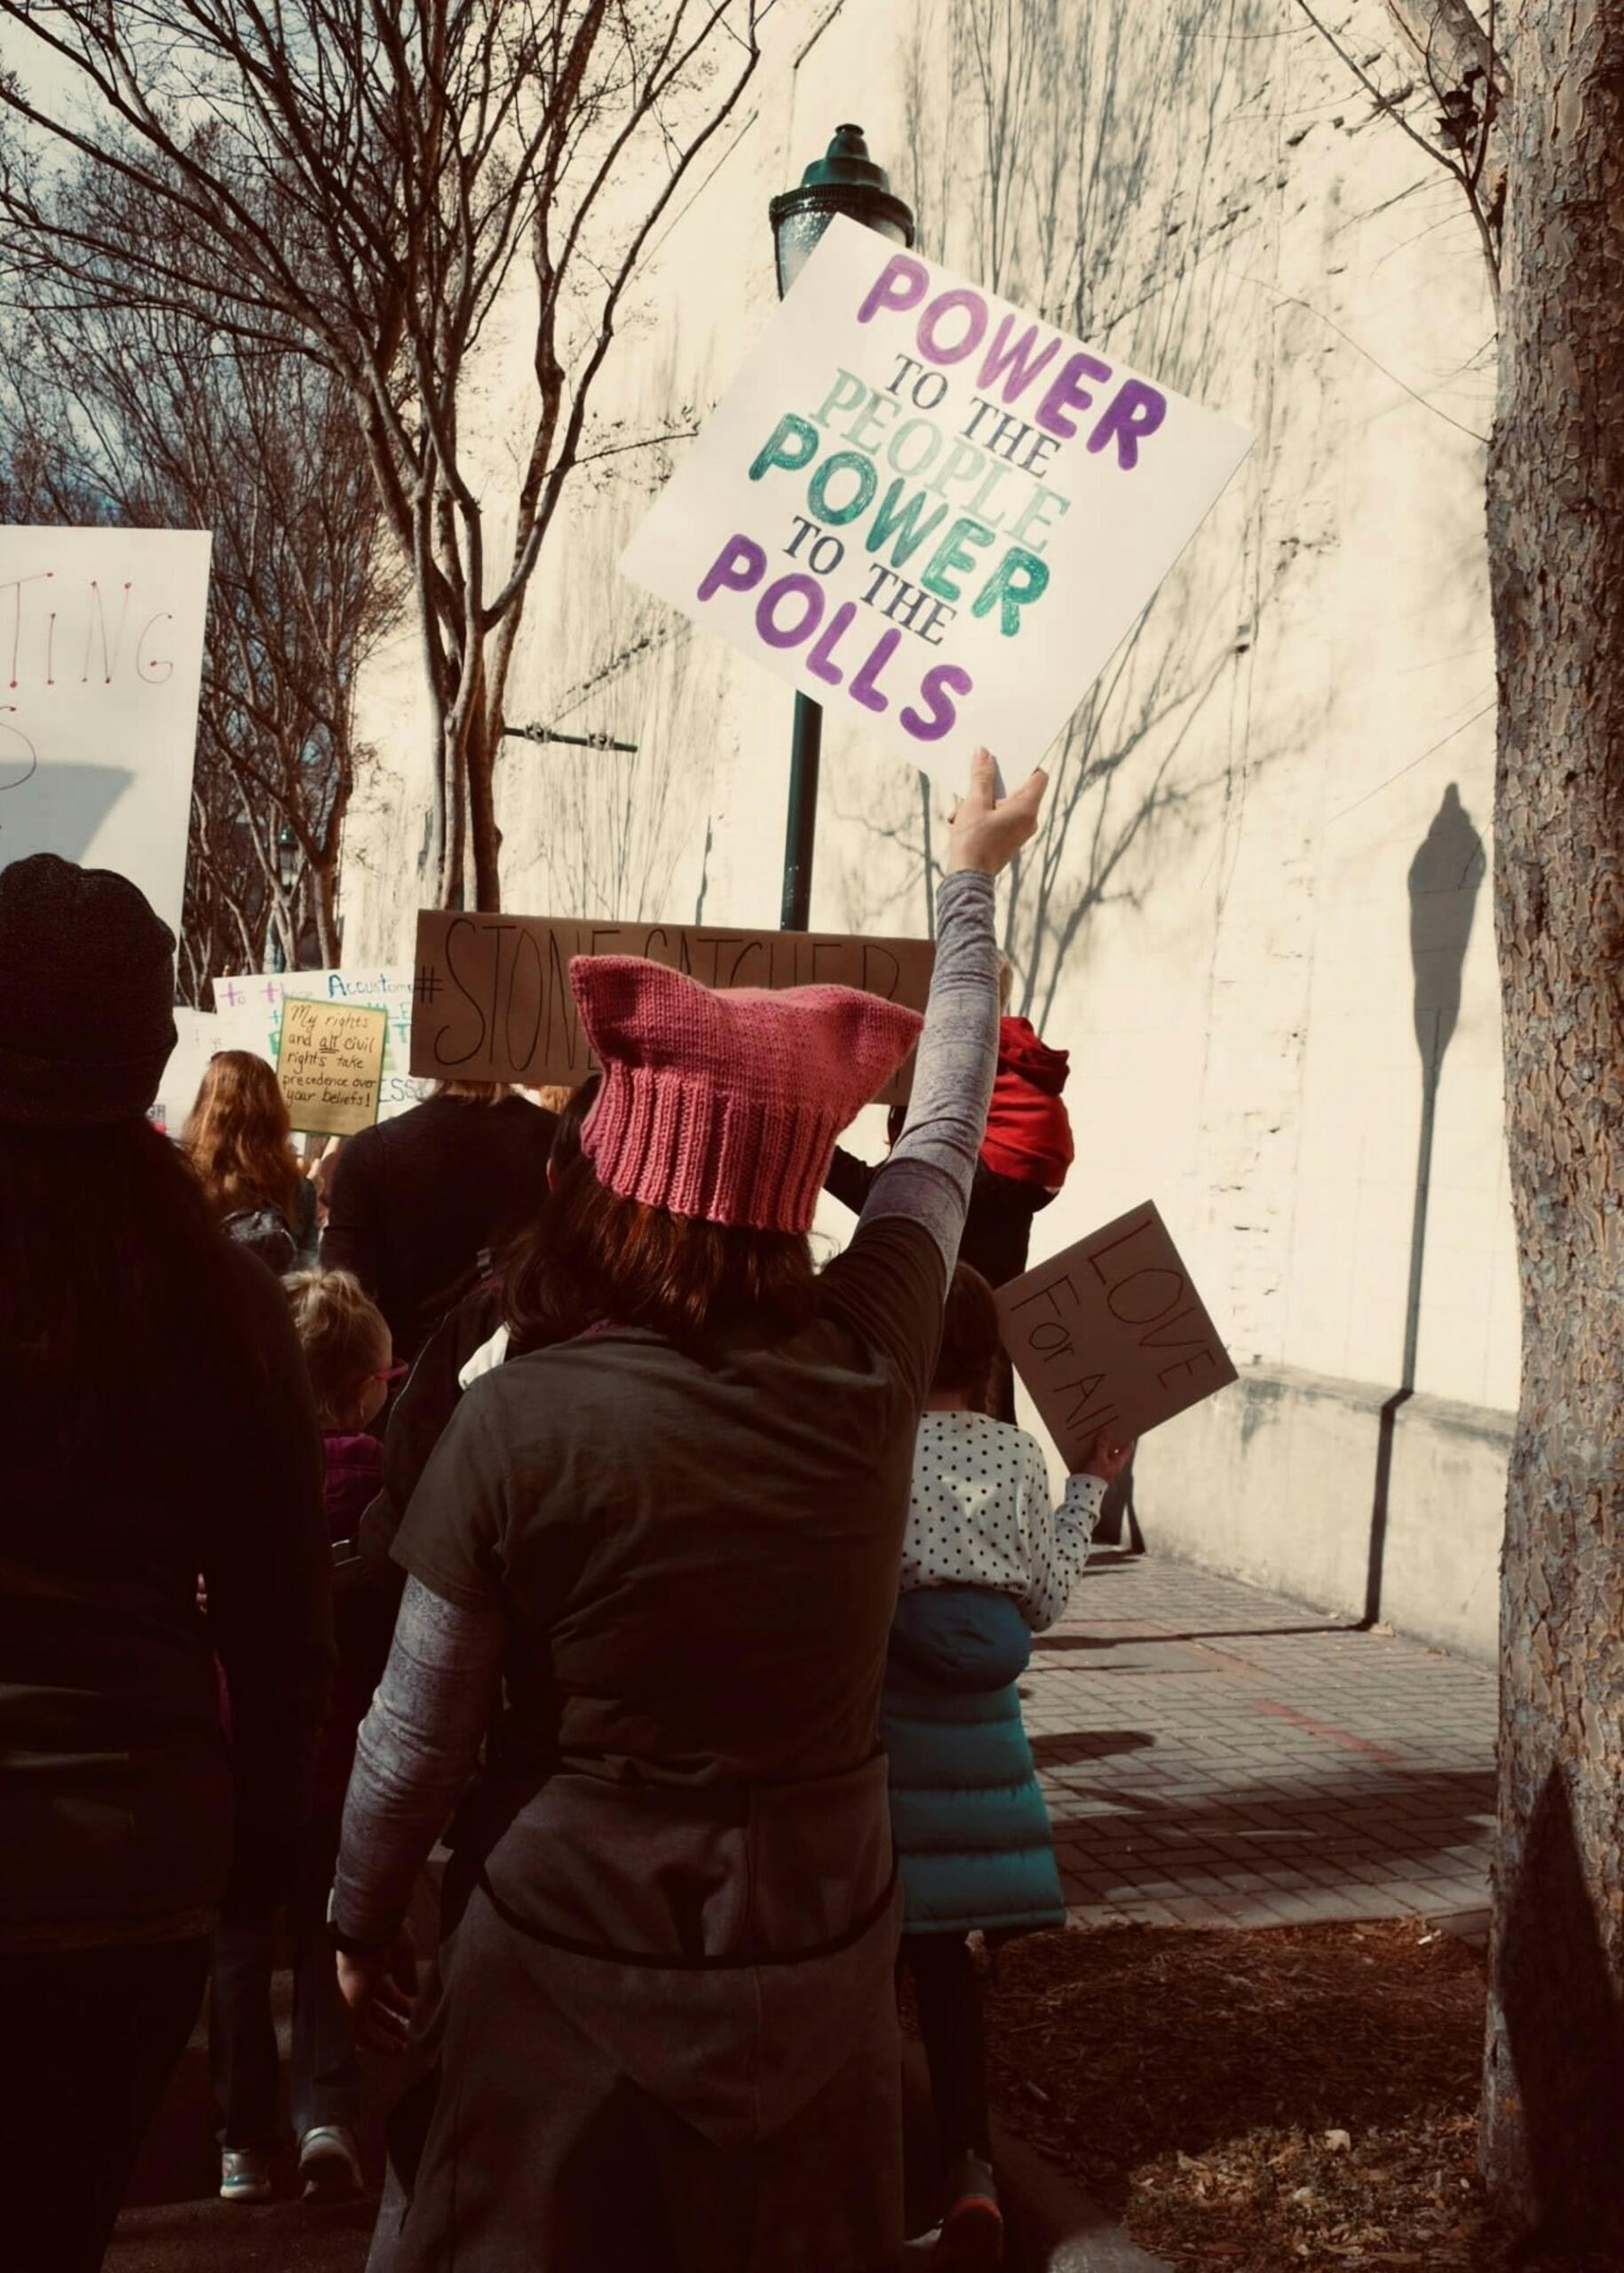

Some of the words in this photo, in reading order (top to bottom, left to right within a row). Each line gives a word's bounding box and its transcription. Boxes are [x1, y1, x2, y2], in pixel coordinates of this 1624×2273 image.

[857, 253, 1168, 471] POWER
[886, 353, 949, 410] TO
[963, 396, 1062, 479] THE
[748, 413, 1050, 638] POWER
[809, 368, 1071, 555] PEOPLE
[697, 534, 974, 742] POLLS
[782, 516, 845, 575] TO
[860, 563, 957, 646] THE
[282, 1072, 348, 1089] precedence
[352, 1078, 376, 1089] over
[287, 1050, 328, 1074] rights
[336, 1055, 364, 1069] take
[289, 1033, 312, 1047] and
[319, 1033, 339, 1049] all
[291, 1004, 318, 1034] My
[325, 1012, 369, 1036] rights
[285, 1089, 316, 1109] your
[321, 1087, 371, 1108] beliefs!
[1087, 1219, 1216, 1391] LOVE
